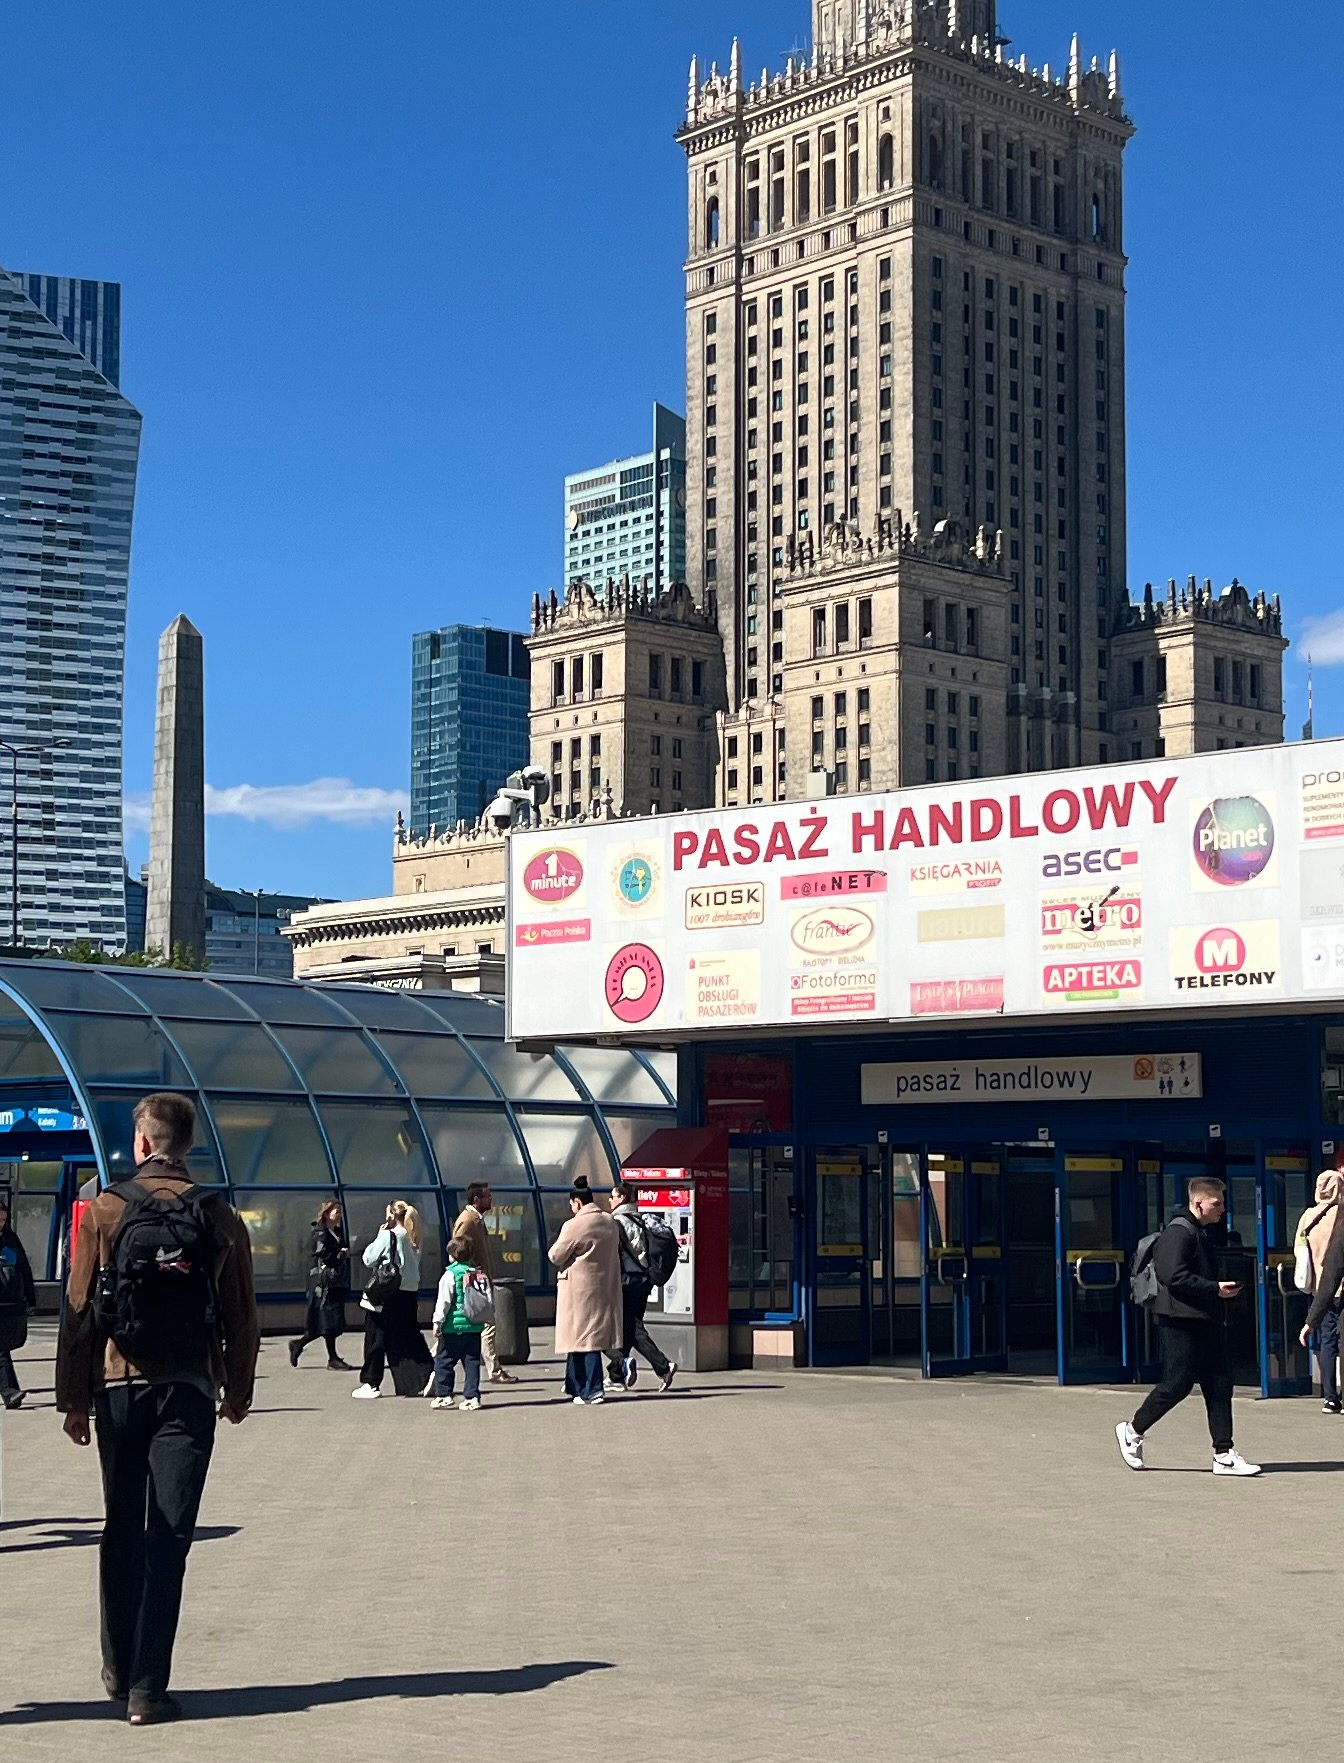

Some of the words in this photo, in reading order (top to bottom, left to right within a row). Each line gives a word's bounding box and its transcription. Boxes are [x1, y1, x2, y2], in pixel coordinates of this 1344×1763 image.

[673, 806, 829, 871] PASAŻ
[851, 777, 1179, 853] HANDLOWY
[1199, 823, 1267, 852] Planet
[544, 853, 559, 877] 1
[910, 860, 1003, 882] KSIĘGARNIA
[531, 872, 577, 891] minute
[690, 887, 760, 908] KIOSK
[1042, 902, 1140, 931] metro
[564, 926, 586, 936] Polska
[1202, 937, 1238, 968] M
[698, 974, 731, 988] PUNKT
[801, 971, 876, 989] Fotoforma
[1047, 963, 1137, 989] APTEKA
[1175, 970, 1276, 990] TELEFONY
[698, 988, 739, 1002] OBSŁUGI
[895, 1067, 962, 1098] pasaż
[975, 1064, 1093, 1094] handlowy
[638, 1190, 659, 1204] ilety
